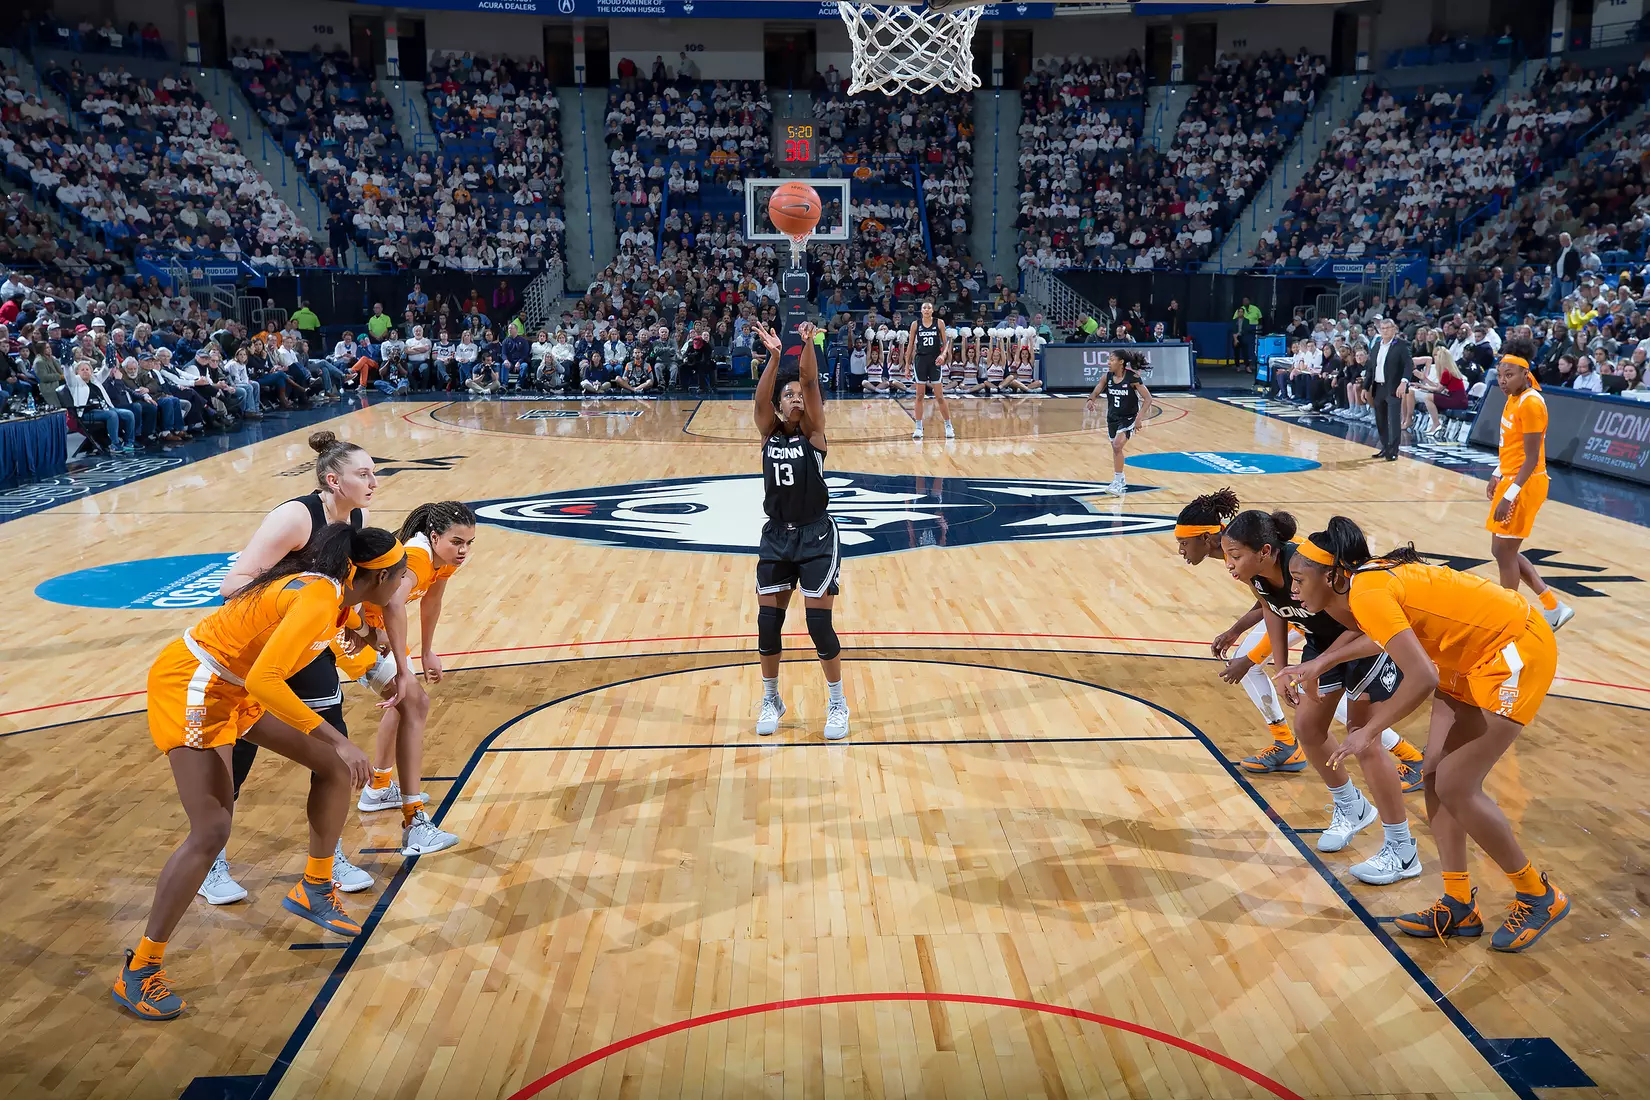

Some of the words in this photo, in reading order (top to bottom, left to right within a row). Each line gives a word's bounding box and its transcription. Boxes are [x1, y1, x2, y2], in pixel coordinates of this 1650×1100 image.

[478, 1, 504, 9] ACURA
[504, 2, 537, 11] DEALERS
[787, 125, 813, 139] 5:20
[785, 139, 809, 162] 30
[1333, 264, 1346, 272] BUD
[1346, 264, 1363, 272] LIGHT
[923, 337, 934, 346] 20
[1113, 396, 1121, 408] 5
[767, 445, 804, 459] UCONN
[1590, 454, 1612, 465] SPORTS
[1610, 459, 1637, 470] NETWORK
[772, 462, 796, 487] 13
